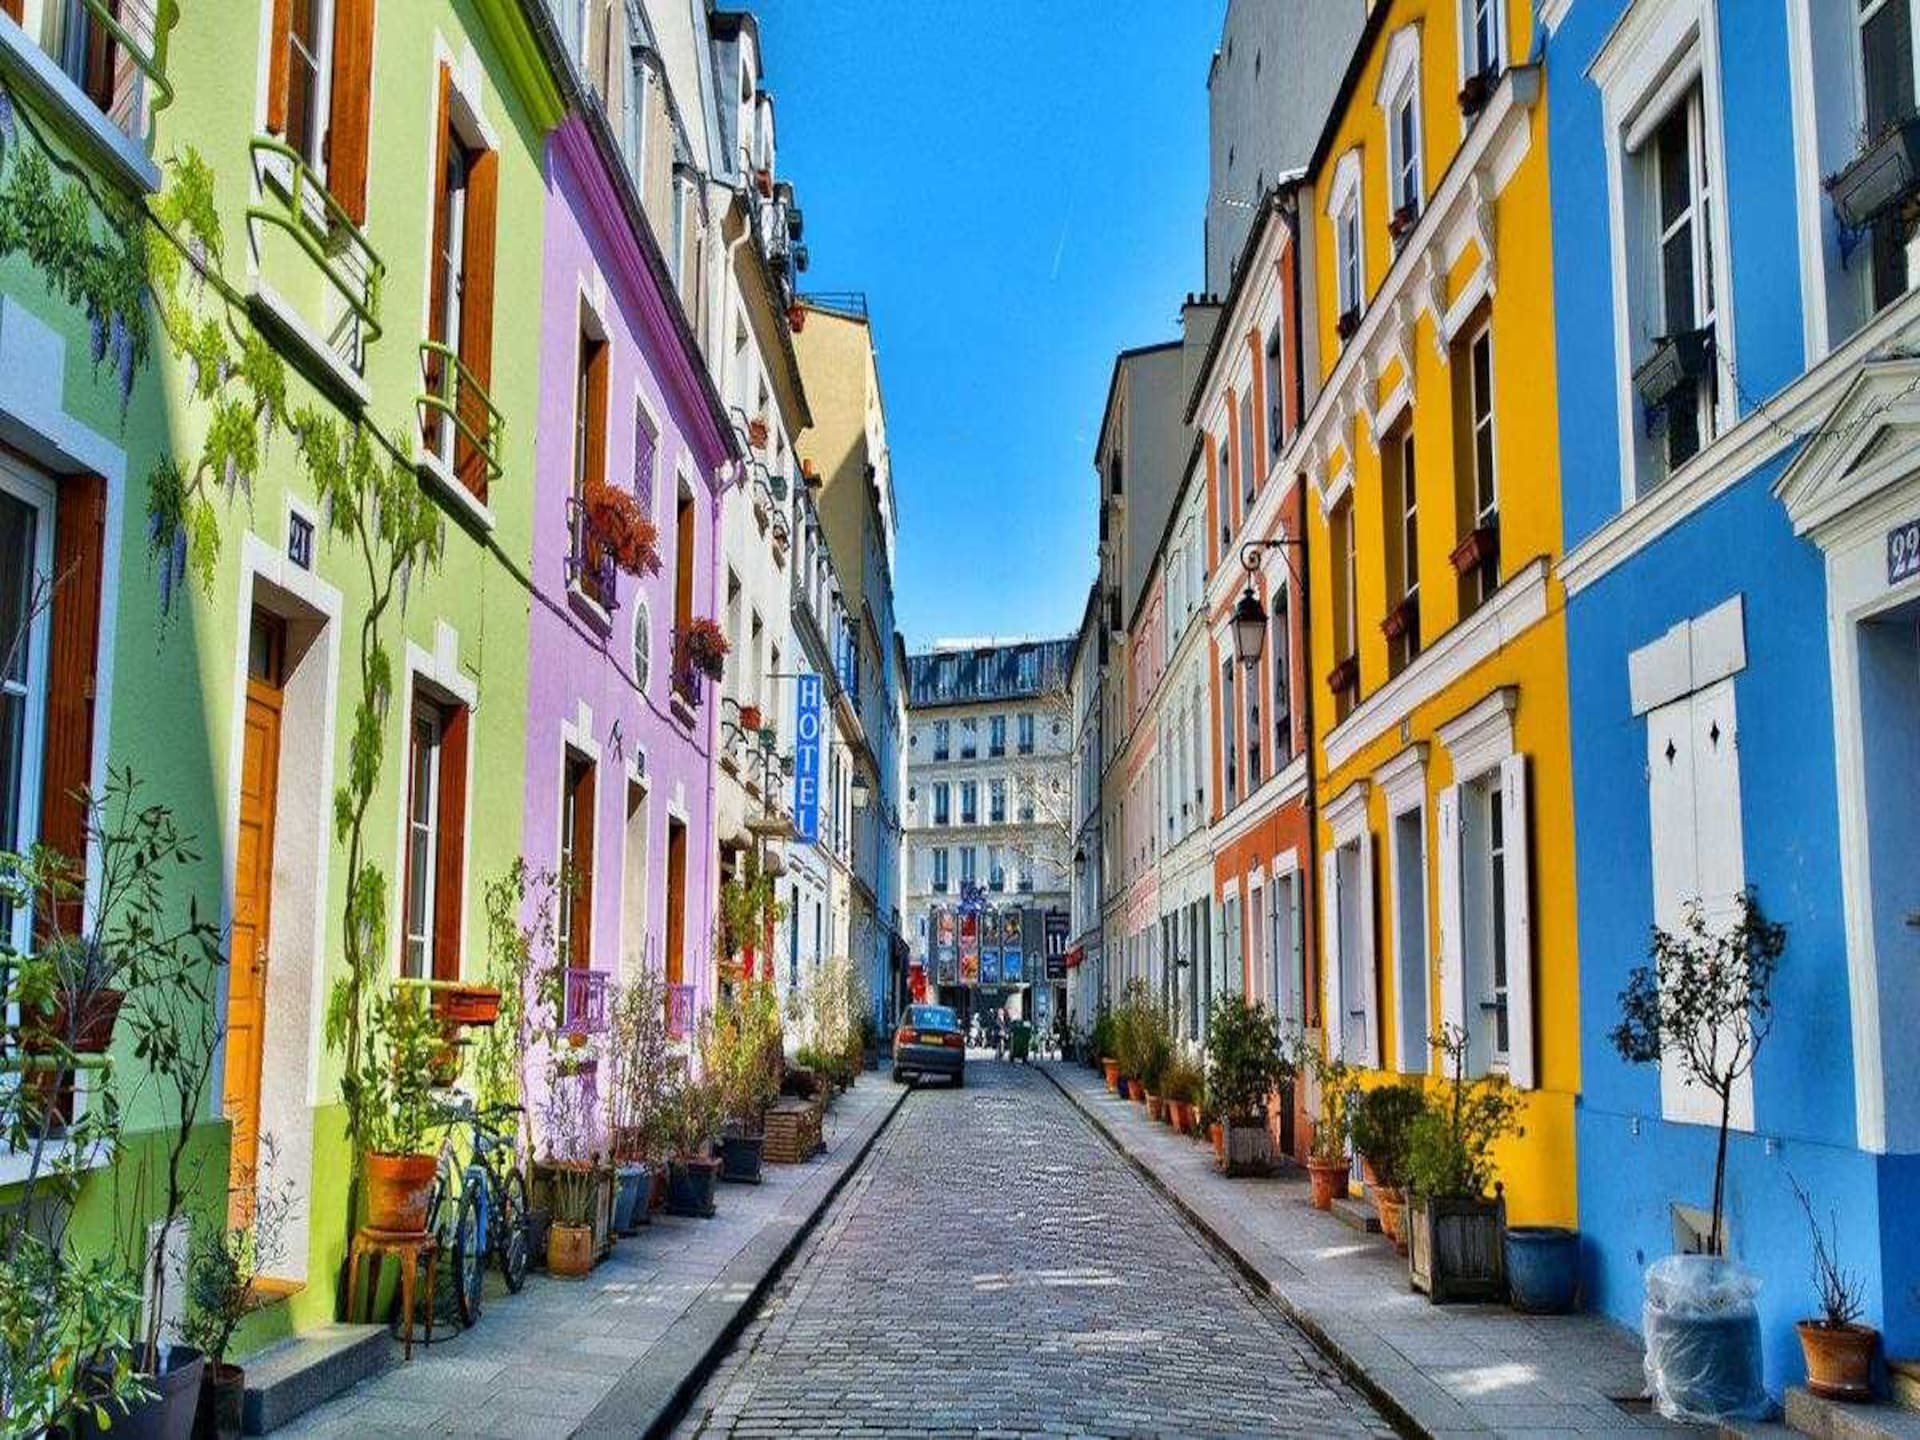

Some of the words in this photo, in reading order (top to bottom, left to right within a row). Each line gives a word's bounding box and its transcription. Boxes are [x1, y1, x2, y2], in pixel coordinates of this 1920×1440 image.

[290, 519, 308, 562] 21
[1891, 526, 1920, 577] 22
[799, 681, 818, 838] HOTEL
